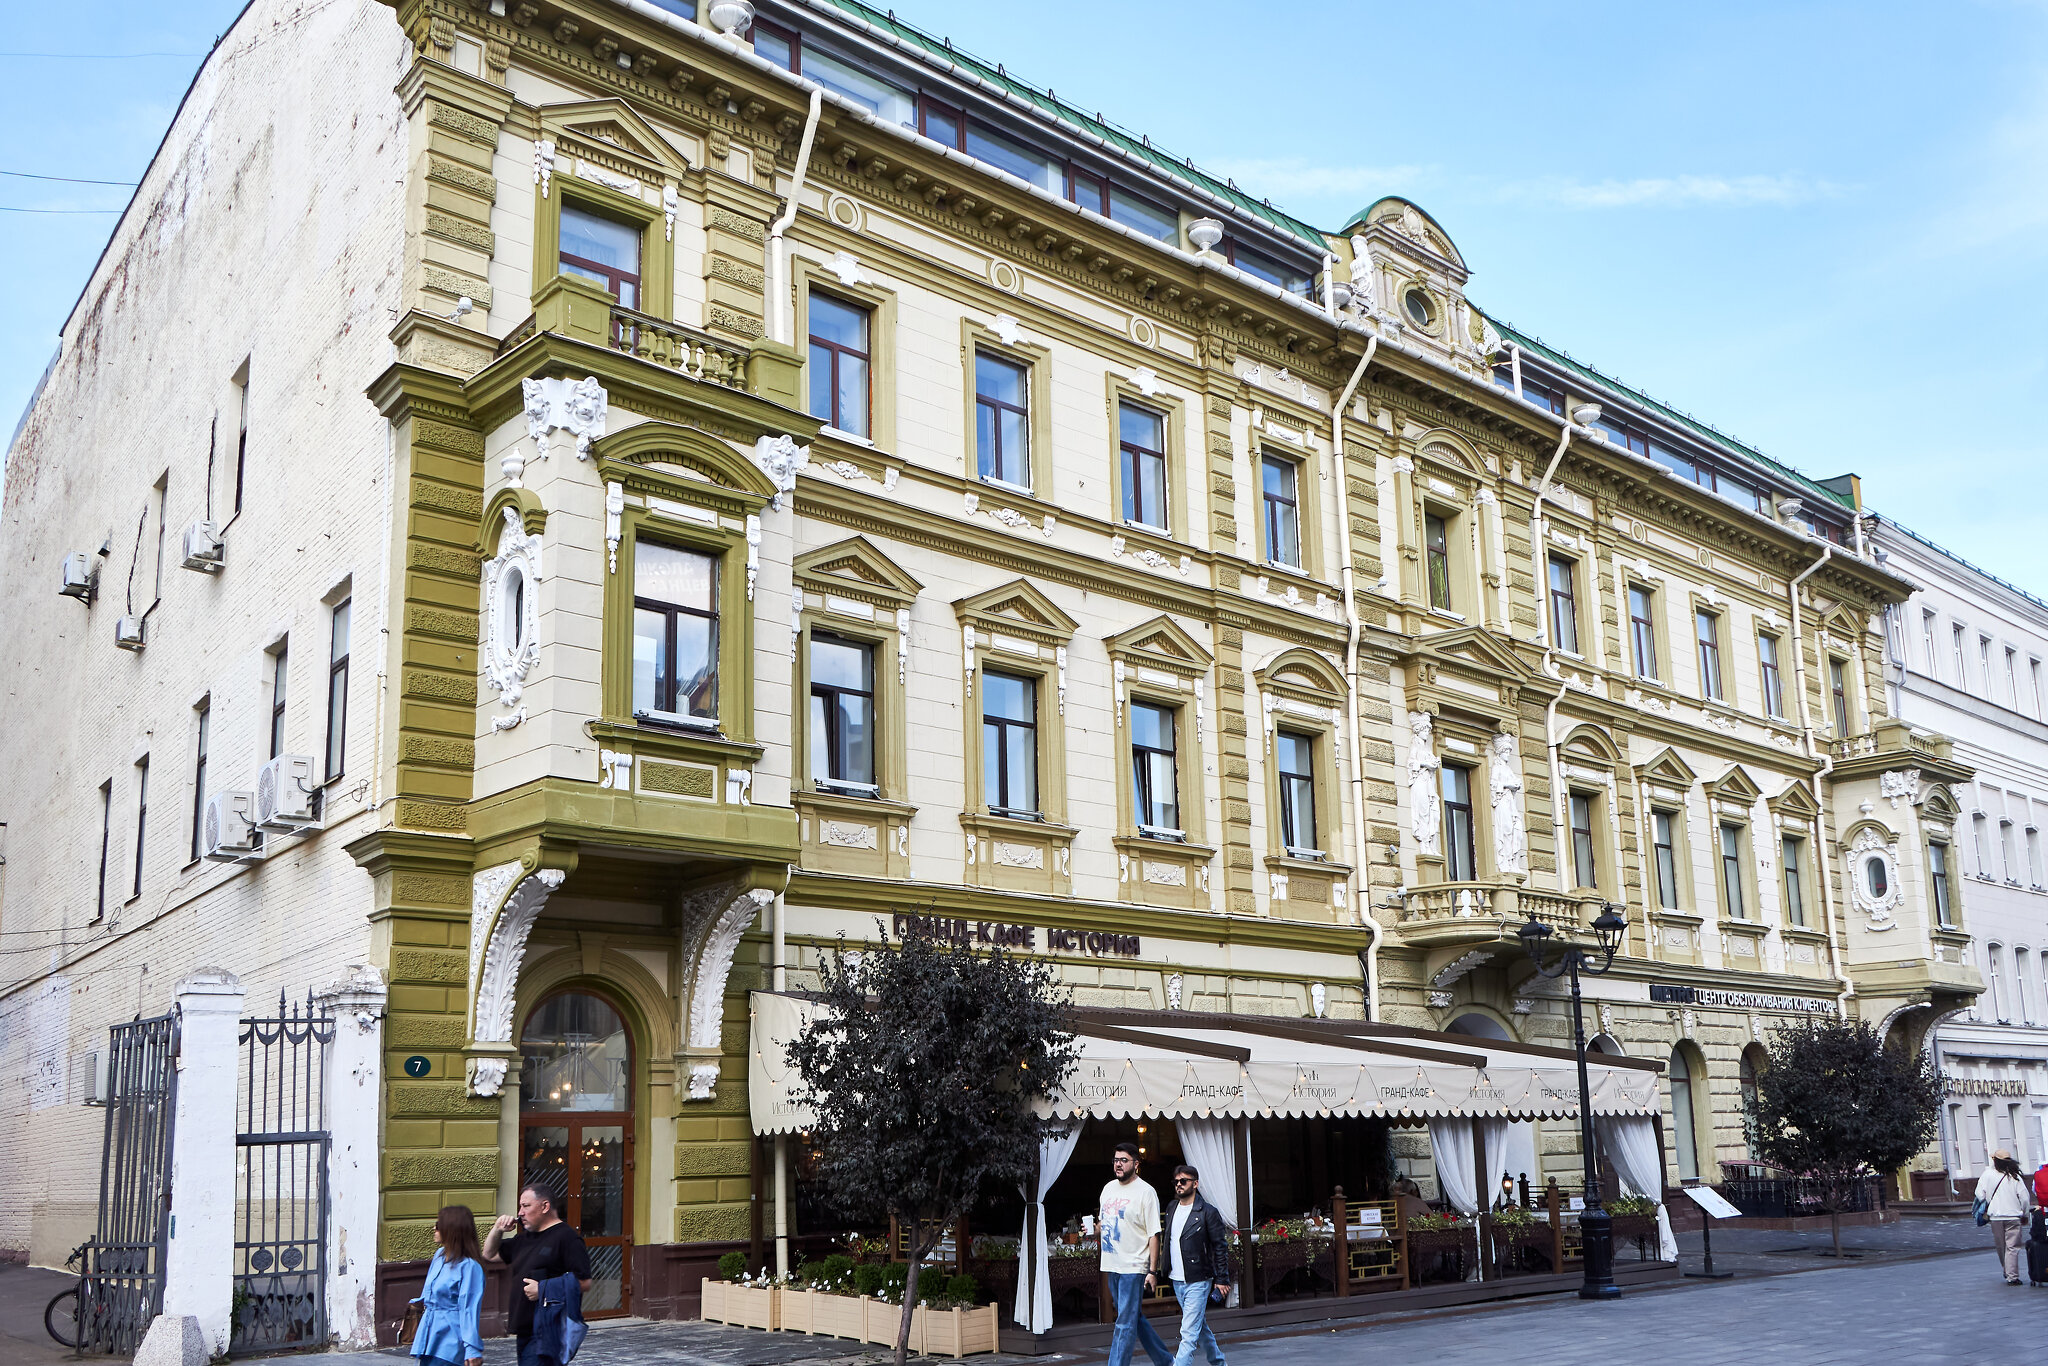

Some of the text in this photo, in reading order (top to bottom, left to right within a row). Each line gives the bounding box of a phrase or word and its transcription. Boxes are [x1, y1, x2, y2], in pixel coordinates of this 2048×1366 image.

[1047, 927, 1140, 955] ИСТОРИЯ
[1649, 984, 1695, 1004] METRO
[1698, 988, 1832, 1013] ЦЕНТР ОБСЛУЖИВАНИЯ КЛИЕНТОВ
[414, 1061, 422, 1072] 7
[1073, 1082, 1127, 1100] История
[1182, 1085, 1244, 1099] ГРАНД-КАФЕ
[1293, 1085, 1337, 1100] История
[1380, 1086, 1430, 1100] ГРАНД-КАФЕ
[1470, 1086, 1505, 1101] История
